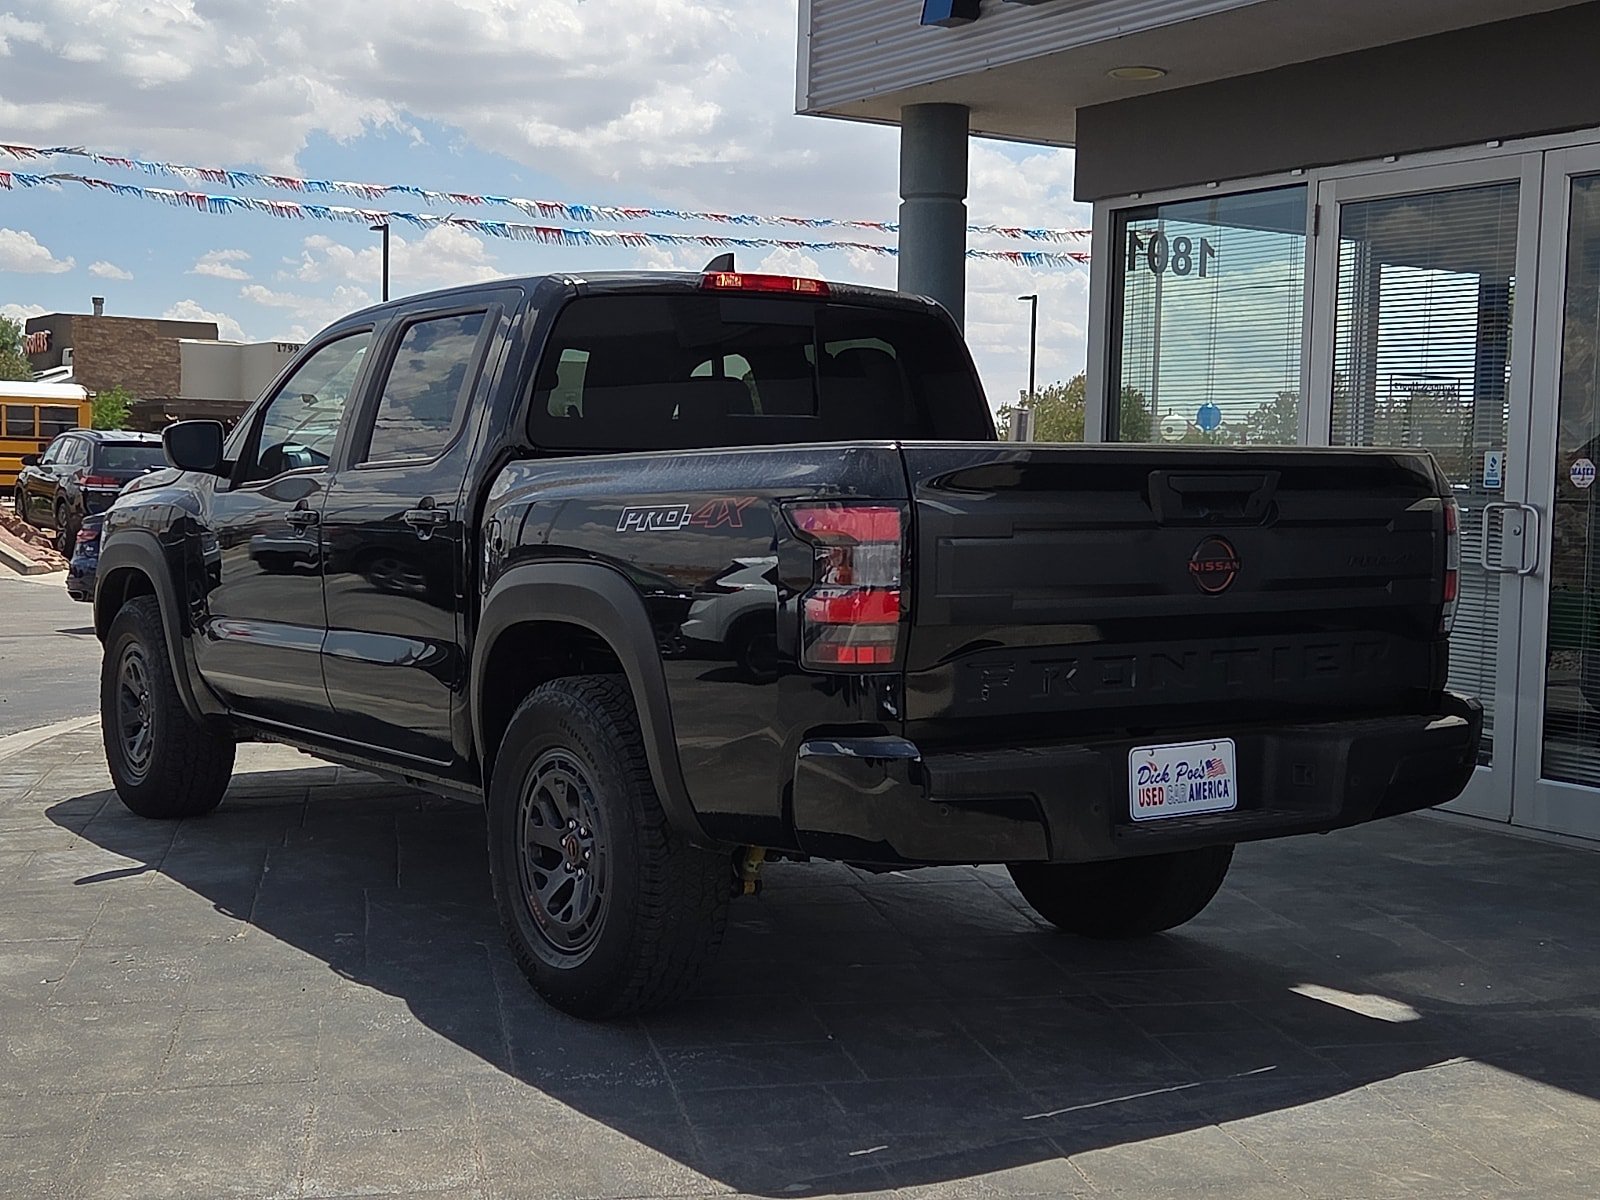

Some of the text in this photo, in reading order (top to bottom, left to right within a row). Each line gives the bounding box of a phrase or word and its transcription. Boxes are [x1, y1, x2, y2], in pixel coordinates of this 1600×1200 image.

[1188, 561, 1240, 573] NISSAN
[966, 643, 1392, 703] FRONTIER
[1137, 763, 1170, 785] Dick
[1139, 787, 1164, 807] USED
[1189, 779, 1230, 801] AMERICA
